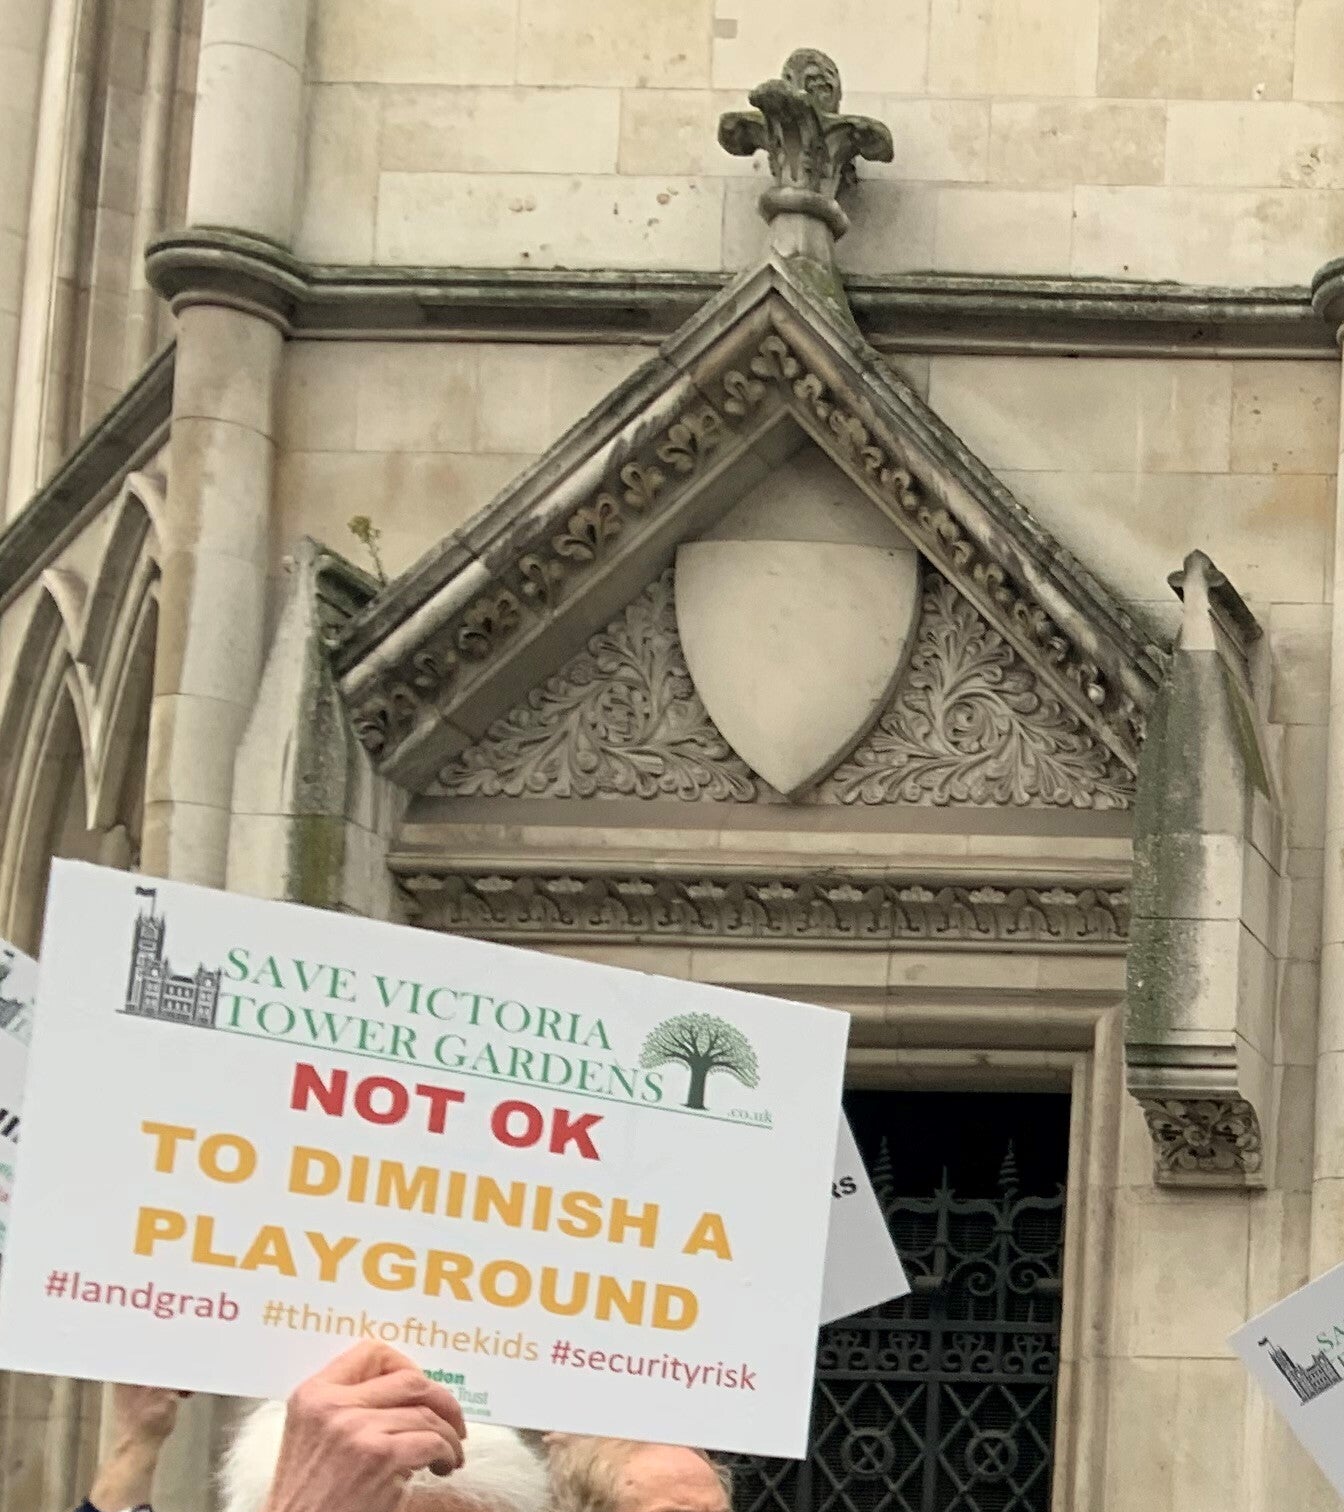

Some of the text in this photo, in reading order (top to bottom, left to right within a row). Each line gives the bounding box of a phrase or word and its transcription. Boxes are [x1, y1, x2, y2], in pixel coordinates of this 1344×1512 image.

[221, 992, 663, 1105] TOWER GARDENS
[222, 949, 613, 1051] SAVE VICTORIA
[290, 1062, 605, 1162] NOT OK
[726, 1108, 773, 1124] .co.uk
[141, 1120, 733, 1262] TO DIMINISH A
[133, 1206, 700, 1332] PLAYGROUND
[45, 1270, 757, 1391] #landgrab #thinkofthekids #securityrisk
